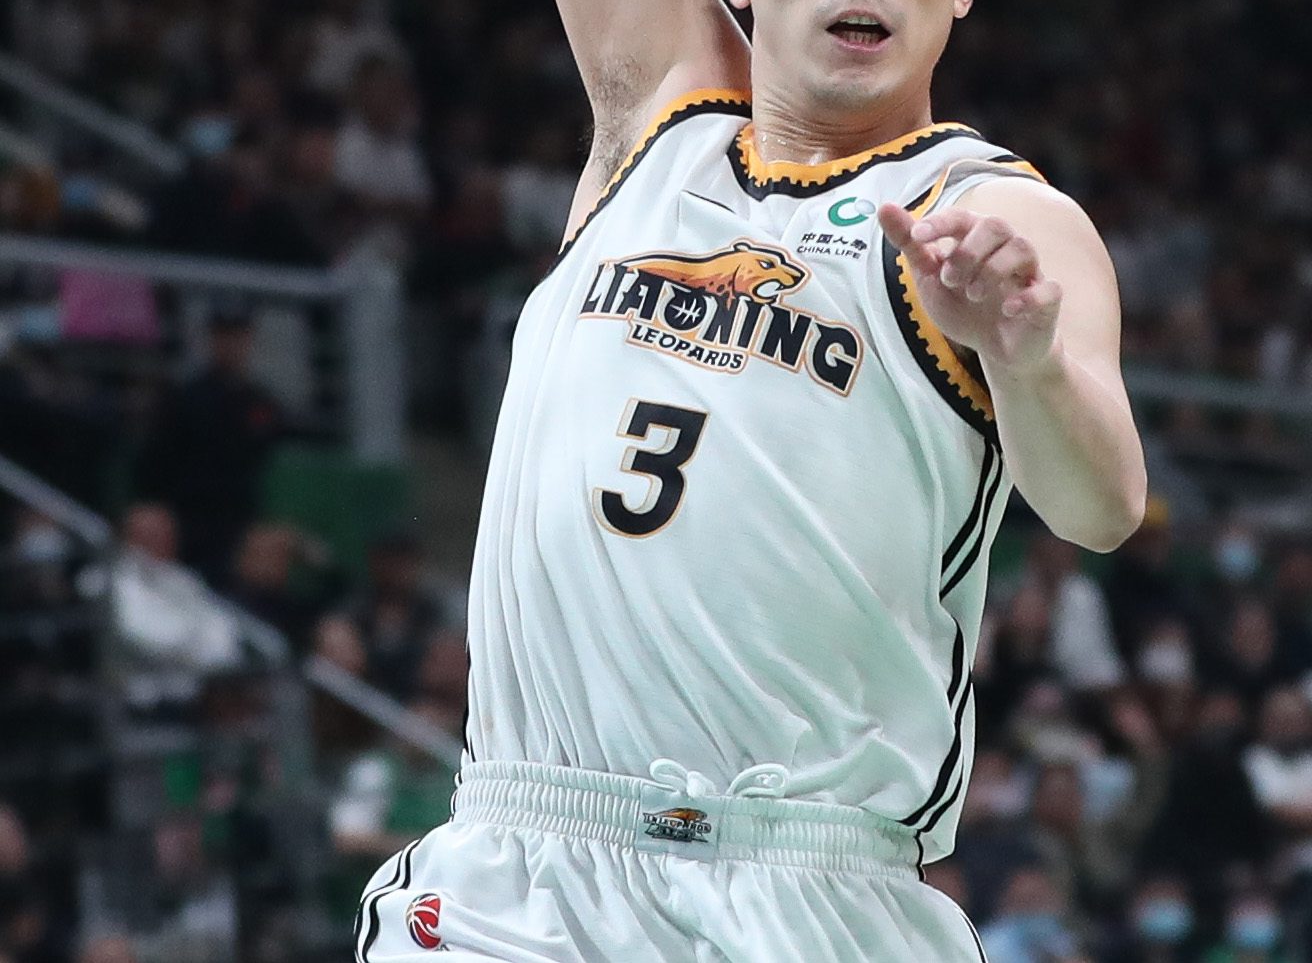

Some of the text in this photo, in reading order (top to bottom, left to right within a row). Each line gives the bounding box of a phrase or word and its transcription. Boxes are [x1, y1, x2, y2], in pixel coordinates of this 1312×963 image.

[797, 245, 862, 260] CHINA LIFE
[802, 233, 868, 251] 中国人寿
[579, 261, 862, 395] LIAONING
[632, 323, 744, 371] LEOPARDS
[594, 398, 709, 538] 3
